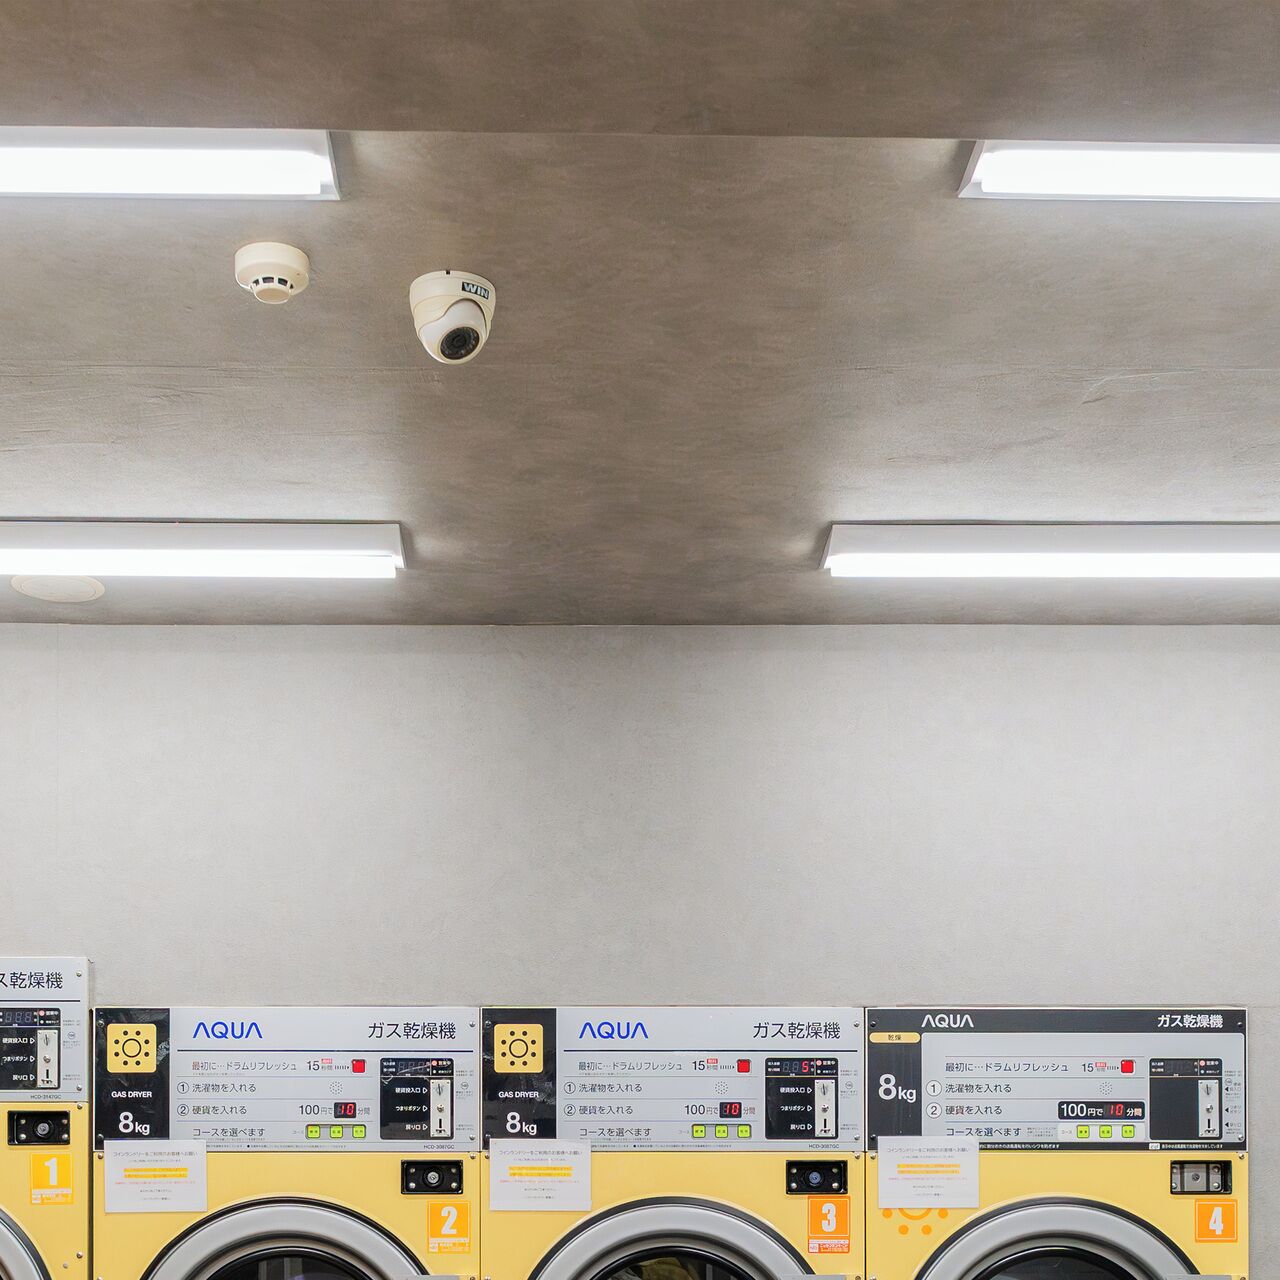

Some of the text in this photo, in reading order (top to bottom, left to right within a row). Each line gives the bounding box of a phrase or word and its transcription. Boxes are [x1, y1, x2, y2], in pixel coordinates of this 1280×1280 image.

[463, 282, 489, 299] WIN
[921, 1015, 974, 1029] AQUA
[1157, 1014, 1224, 1029] ガス乾燥機
[192, 1021, 263, 1040] AQUA
[367, 1021, 457, 1041] ガス乾燥機
[578, 1021, 649, 1040] AQUA
[752, 1021, 841, 1041] ガス乾燥機
[887, 1034, 902, 1042] 乾燥
[801, 1060, 809, 1073] 5
[1081, 1062, 1094, 1073] 15
[111, 1090, 152, 1098] GAS DRYER
[192, 1082, 257, 1094] 洗濯物を入れる
[498, 1090, 539, 1098] GAS DRYER
[578, 1082, 642, 1094] 洗濯物を入れる
[878, 1073, 917, 1103] 8kg
[945, 1083, 1012, 1094] 洗濯物を入れる
[192, 1104, 247, 1116] 硬貨を入れる
[340, 1103, 355, 1116] 10
[578, 1104, 633, 1116] 硬貨を入れる
[724, 1103, 740, 1116] 10
[945, 1105, 1003, 1116] 硬貨を入れる
[118, 1111, 151, 1135] 8kg
[505, 1111, 538, 1136] 8kg
[192, 1126, 265, 1138] コースを選べます
[578, 1126, 652, 1138] コースを選べます
[946, 1126, 1022, 1138] コースを選べます
[44, 1157, 57, 1186] 1
[440, 1206, 458, 1235] 2
[821, 1202, 837, 1233] 3
[1208, 1206, 1225, 1236] 4
